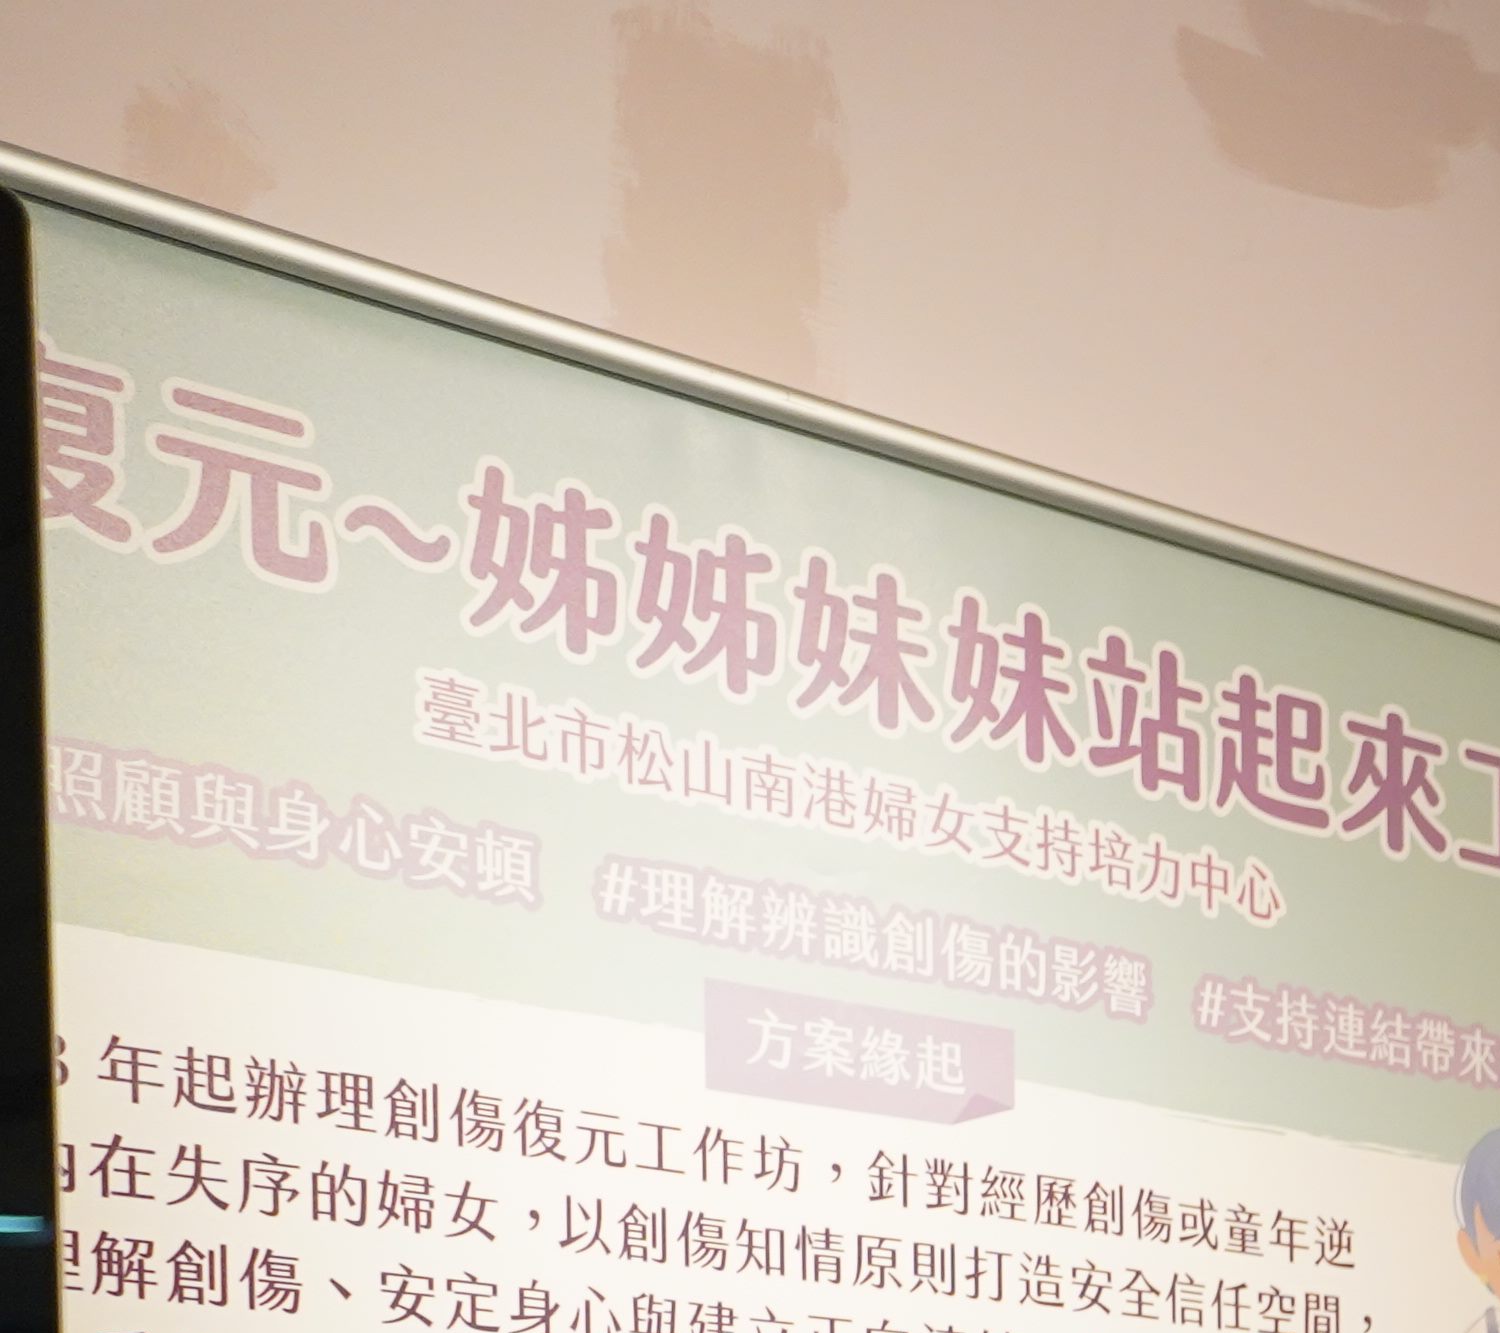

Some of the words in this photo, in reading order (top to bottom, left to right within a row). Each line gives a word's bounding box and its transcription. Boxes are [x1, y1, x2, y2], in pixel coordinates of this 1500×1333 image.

[49, 744, 539, 906] 照顧與身心安頓
[599, 864, 1150, 1018] #理解辨識創傷的影響
[422, 676, 1283, 923] 臺北市松山南港婦女支持培力中心
[97, 1034, 1357, 1270] 年起辦理創傷復元工作坊，針對經歷創傷或童年逆
[745, 1006, 967, 1095] 方案緣起
